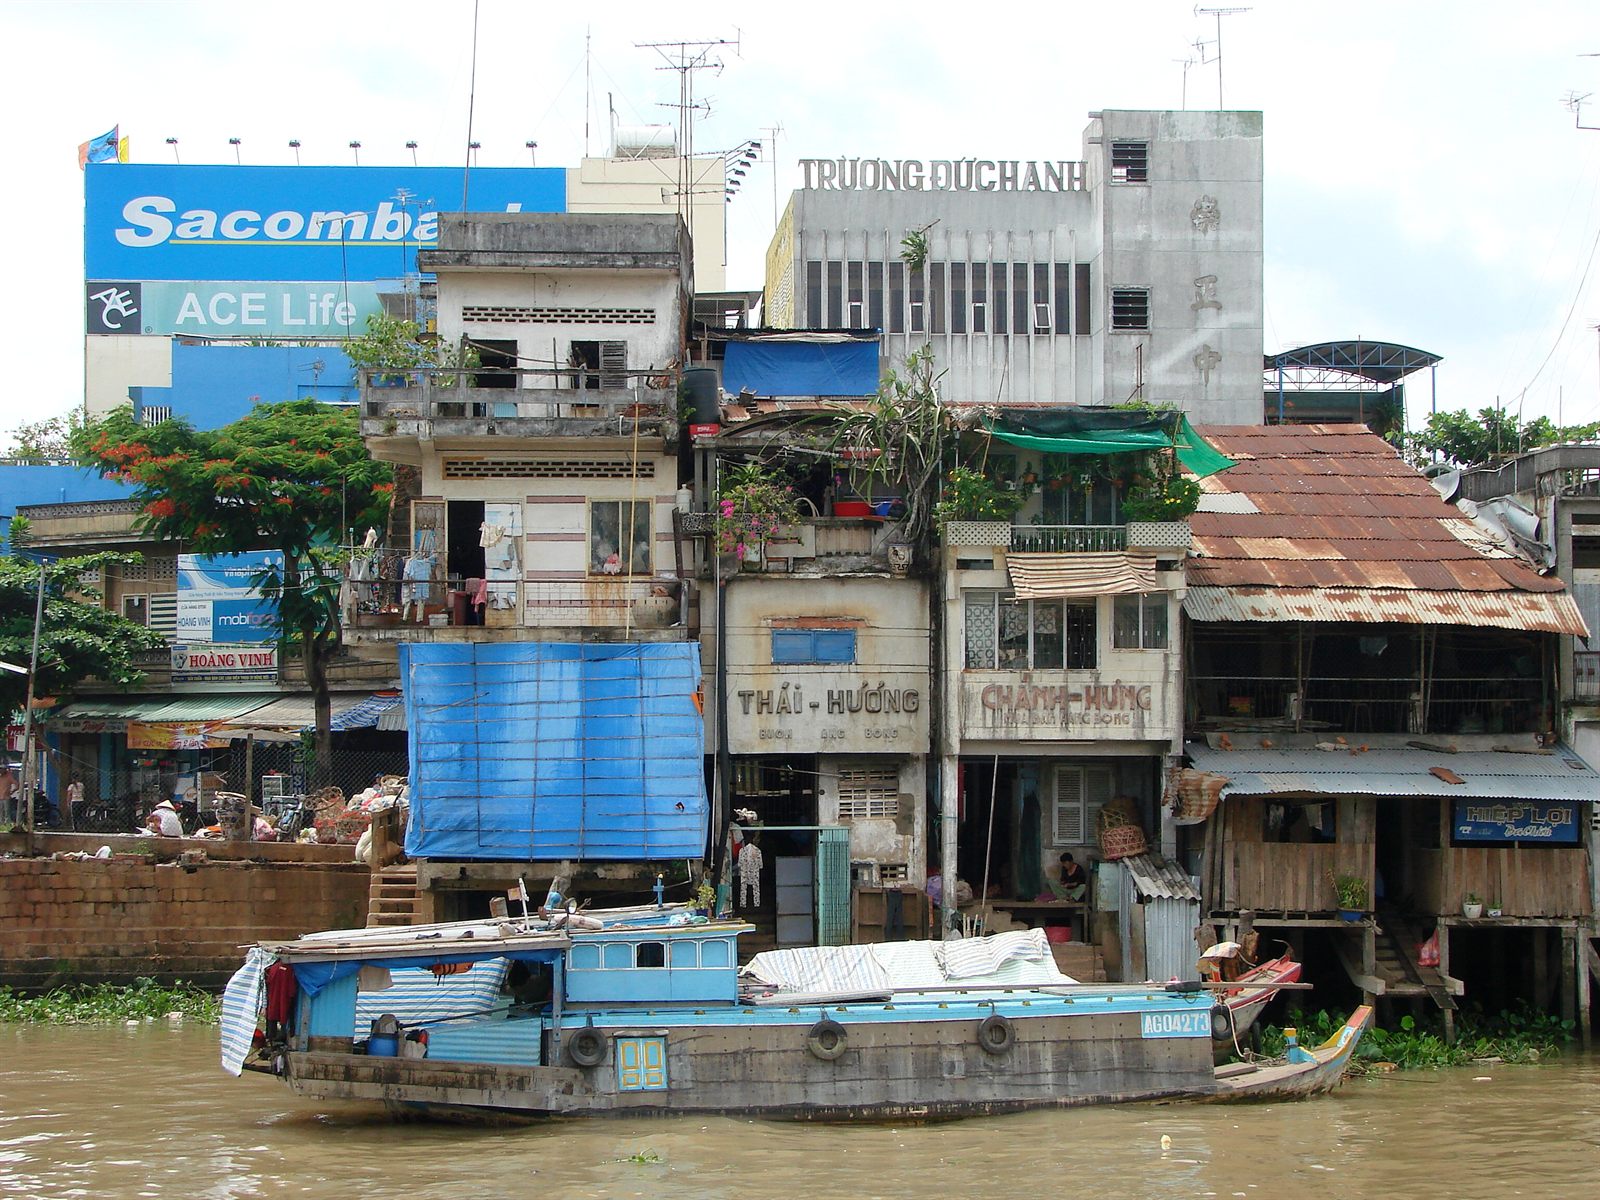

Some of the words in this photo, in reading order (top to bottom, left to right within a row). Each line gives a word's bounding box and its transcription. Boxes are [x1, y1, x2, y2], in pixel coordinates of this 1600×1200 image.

[115, 196, 523, 248] Sacomba
[175, 292, 266, 326] ACE
[283, 292, 357, 326] Life
[189, 651, 235, 667] HOÀNG
[238, 653, 273, 666] VINH
[1466, 804, 1524, 826] HIỆP
[1531, 806, 1572, 827] LỢI
[1144, 1013, 1209, 1033] AG04273
